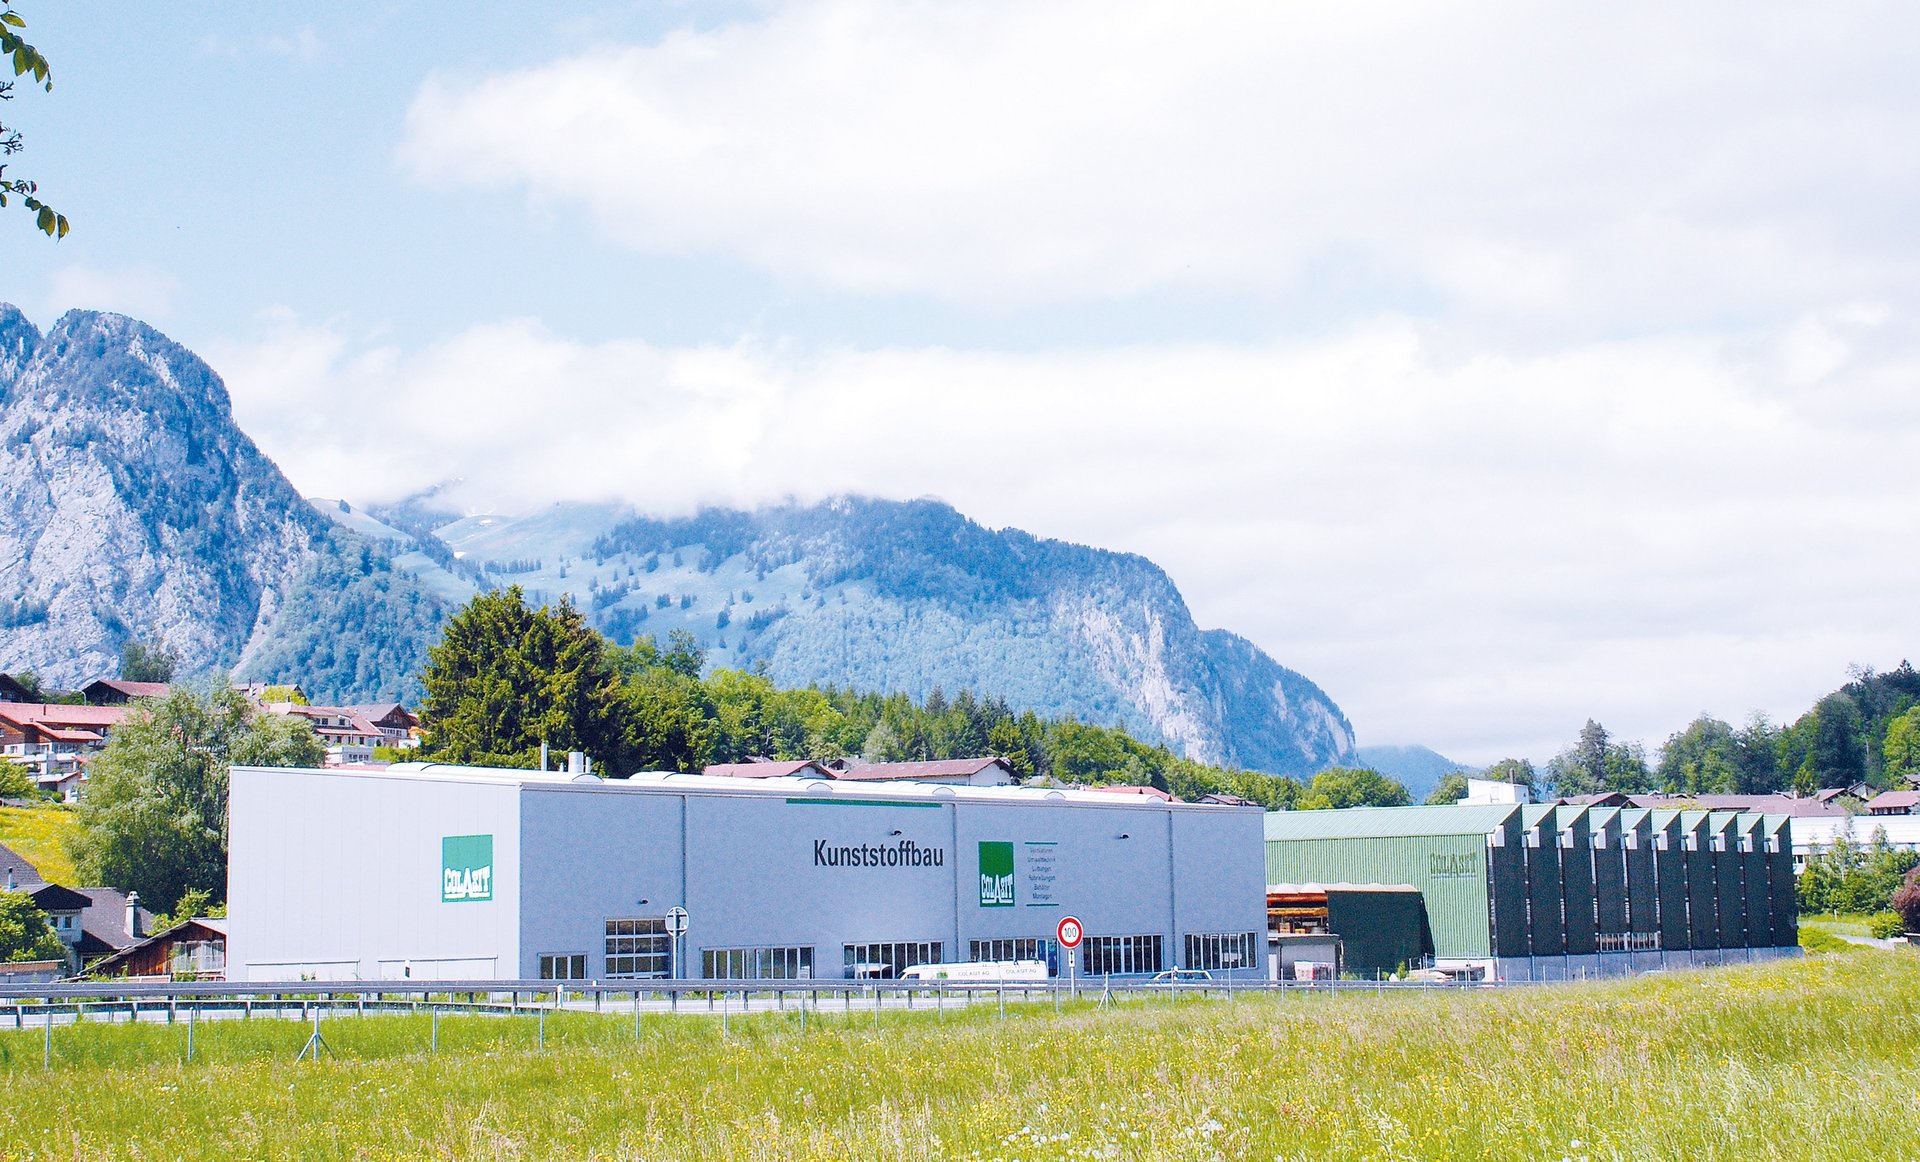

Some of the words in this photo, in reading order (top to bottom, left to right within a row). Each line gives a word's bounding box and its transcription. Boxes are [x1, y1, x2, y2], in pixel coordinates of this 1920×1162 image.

[814, 839, 944, 867] Kunststoffbau
[981, 873, 1014, 904] COLASIT
[1064, 927, 1077, 938] 100
